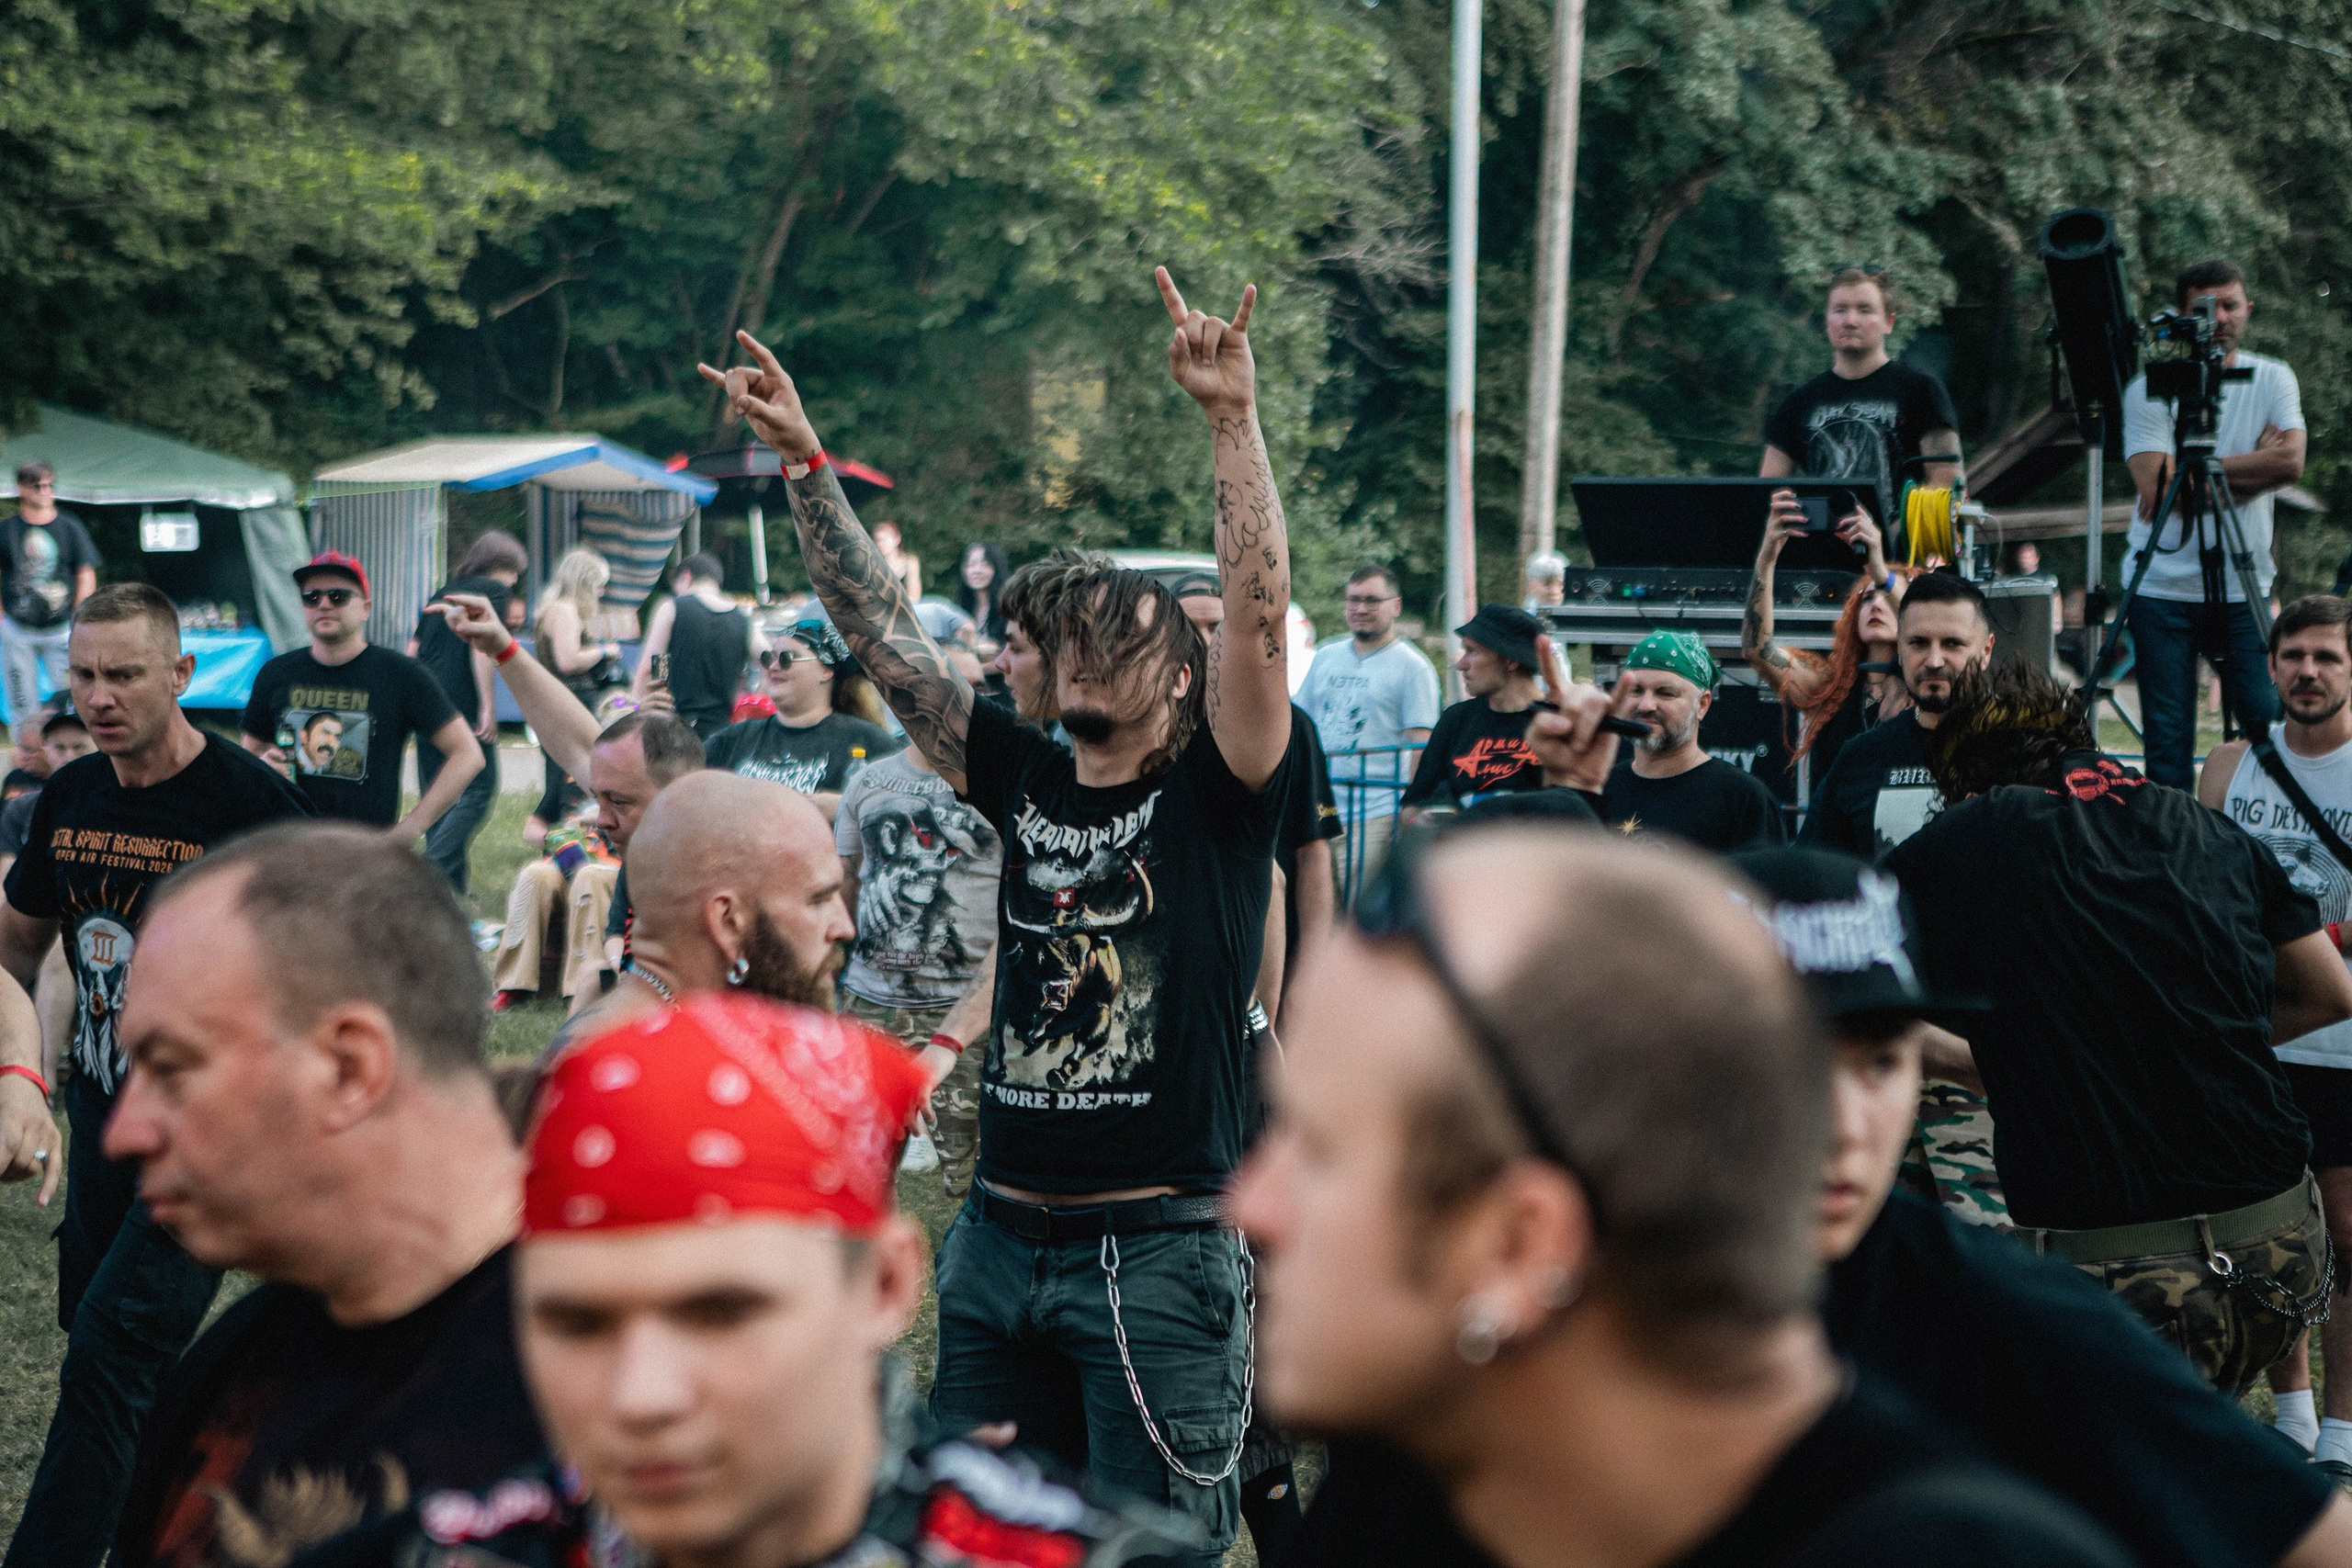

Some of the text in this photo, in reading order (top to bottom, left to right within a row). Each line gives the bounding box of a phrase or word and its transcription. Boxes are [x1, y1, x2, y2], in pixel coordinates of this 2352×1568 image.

[290, 688, 369, 710] QUEEN
[2231, 796, 2266, 826] PIG
[74, 829, 113, 852] SPIRIT
[55, 850, 76, 862] OPEN
[80, 852, 96, 863] AIR
[100, 853, 145, 871] FESTIVAL
[995, 1086, 1050, 1110] MORE
[1057, 1091, 1153, 1111] DEATH
